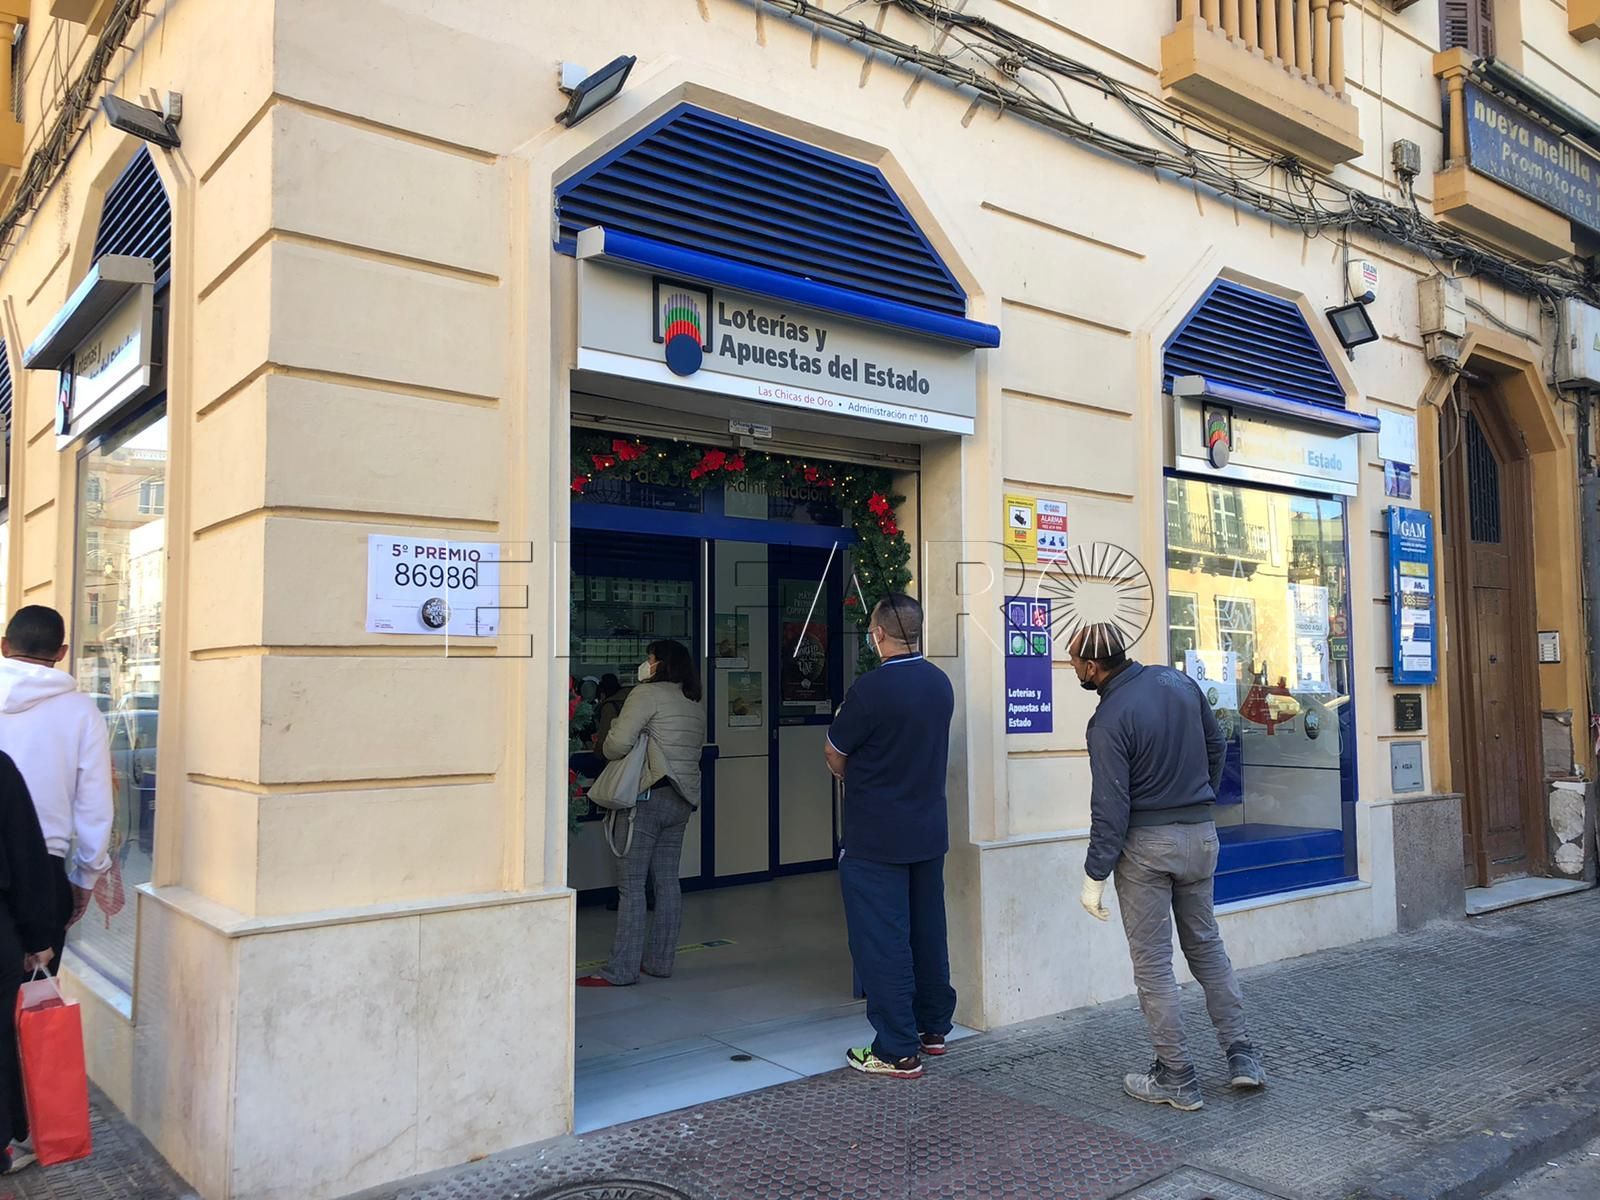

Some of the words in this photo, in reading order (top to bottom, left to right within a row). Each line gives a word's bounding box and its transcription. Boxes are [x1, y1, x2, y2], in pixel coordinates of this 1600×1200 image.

[1475, 100, 1529, 147] nueva
[1534, 135, 1590, 183] melilla
[1503, 142, 1592, 207] Promotores
[718, 302, 809, 343] Loterías
[815, 328, 827, 352] y
[719, 333, 822, 375] Apuestas
[828, 354, 858, 382] del
[864, 362, 930, 395] Estado
[758, 385, 772, 397] Las
[774, 388, 802, 402] Chicas
[804, 394, 815, 405] de
[817, 396, 834, 408] Oro
[848, 402, 908, 421] Administración
[920, 414, 929, 424] 10
[1307, 450, 1343, 471] Estado
[1401, 520, 1426, 539] GAM
[392, 544, 409, 558] 5º
[415, 545, 481, 563] PREMIO
[394, 562, 477, 590] 86986
[1008, 688, 1035, 698] Loterías
[1036, 690, 1042, 700] y
[1008, 703, 1039, 715] Apuestas
[1040, 702, 1051, 712] del
[1008, 717, 1032, 728] Estado
